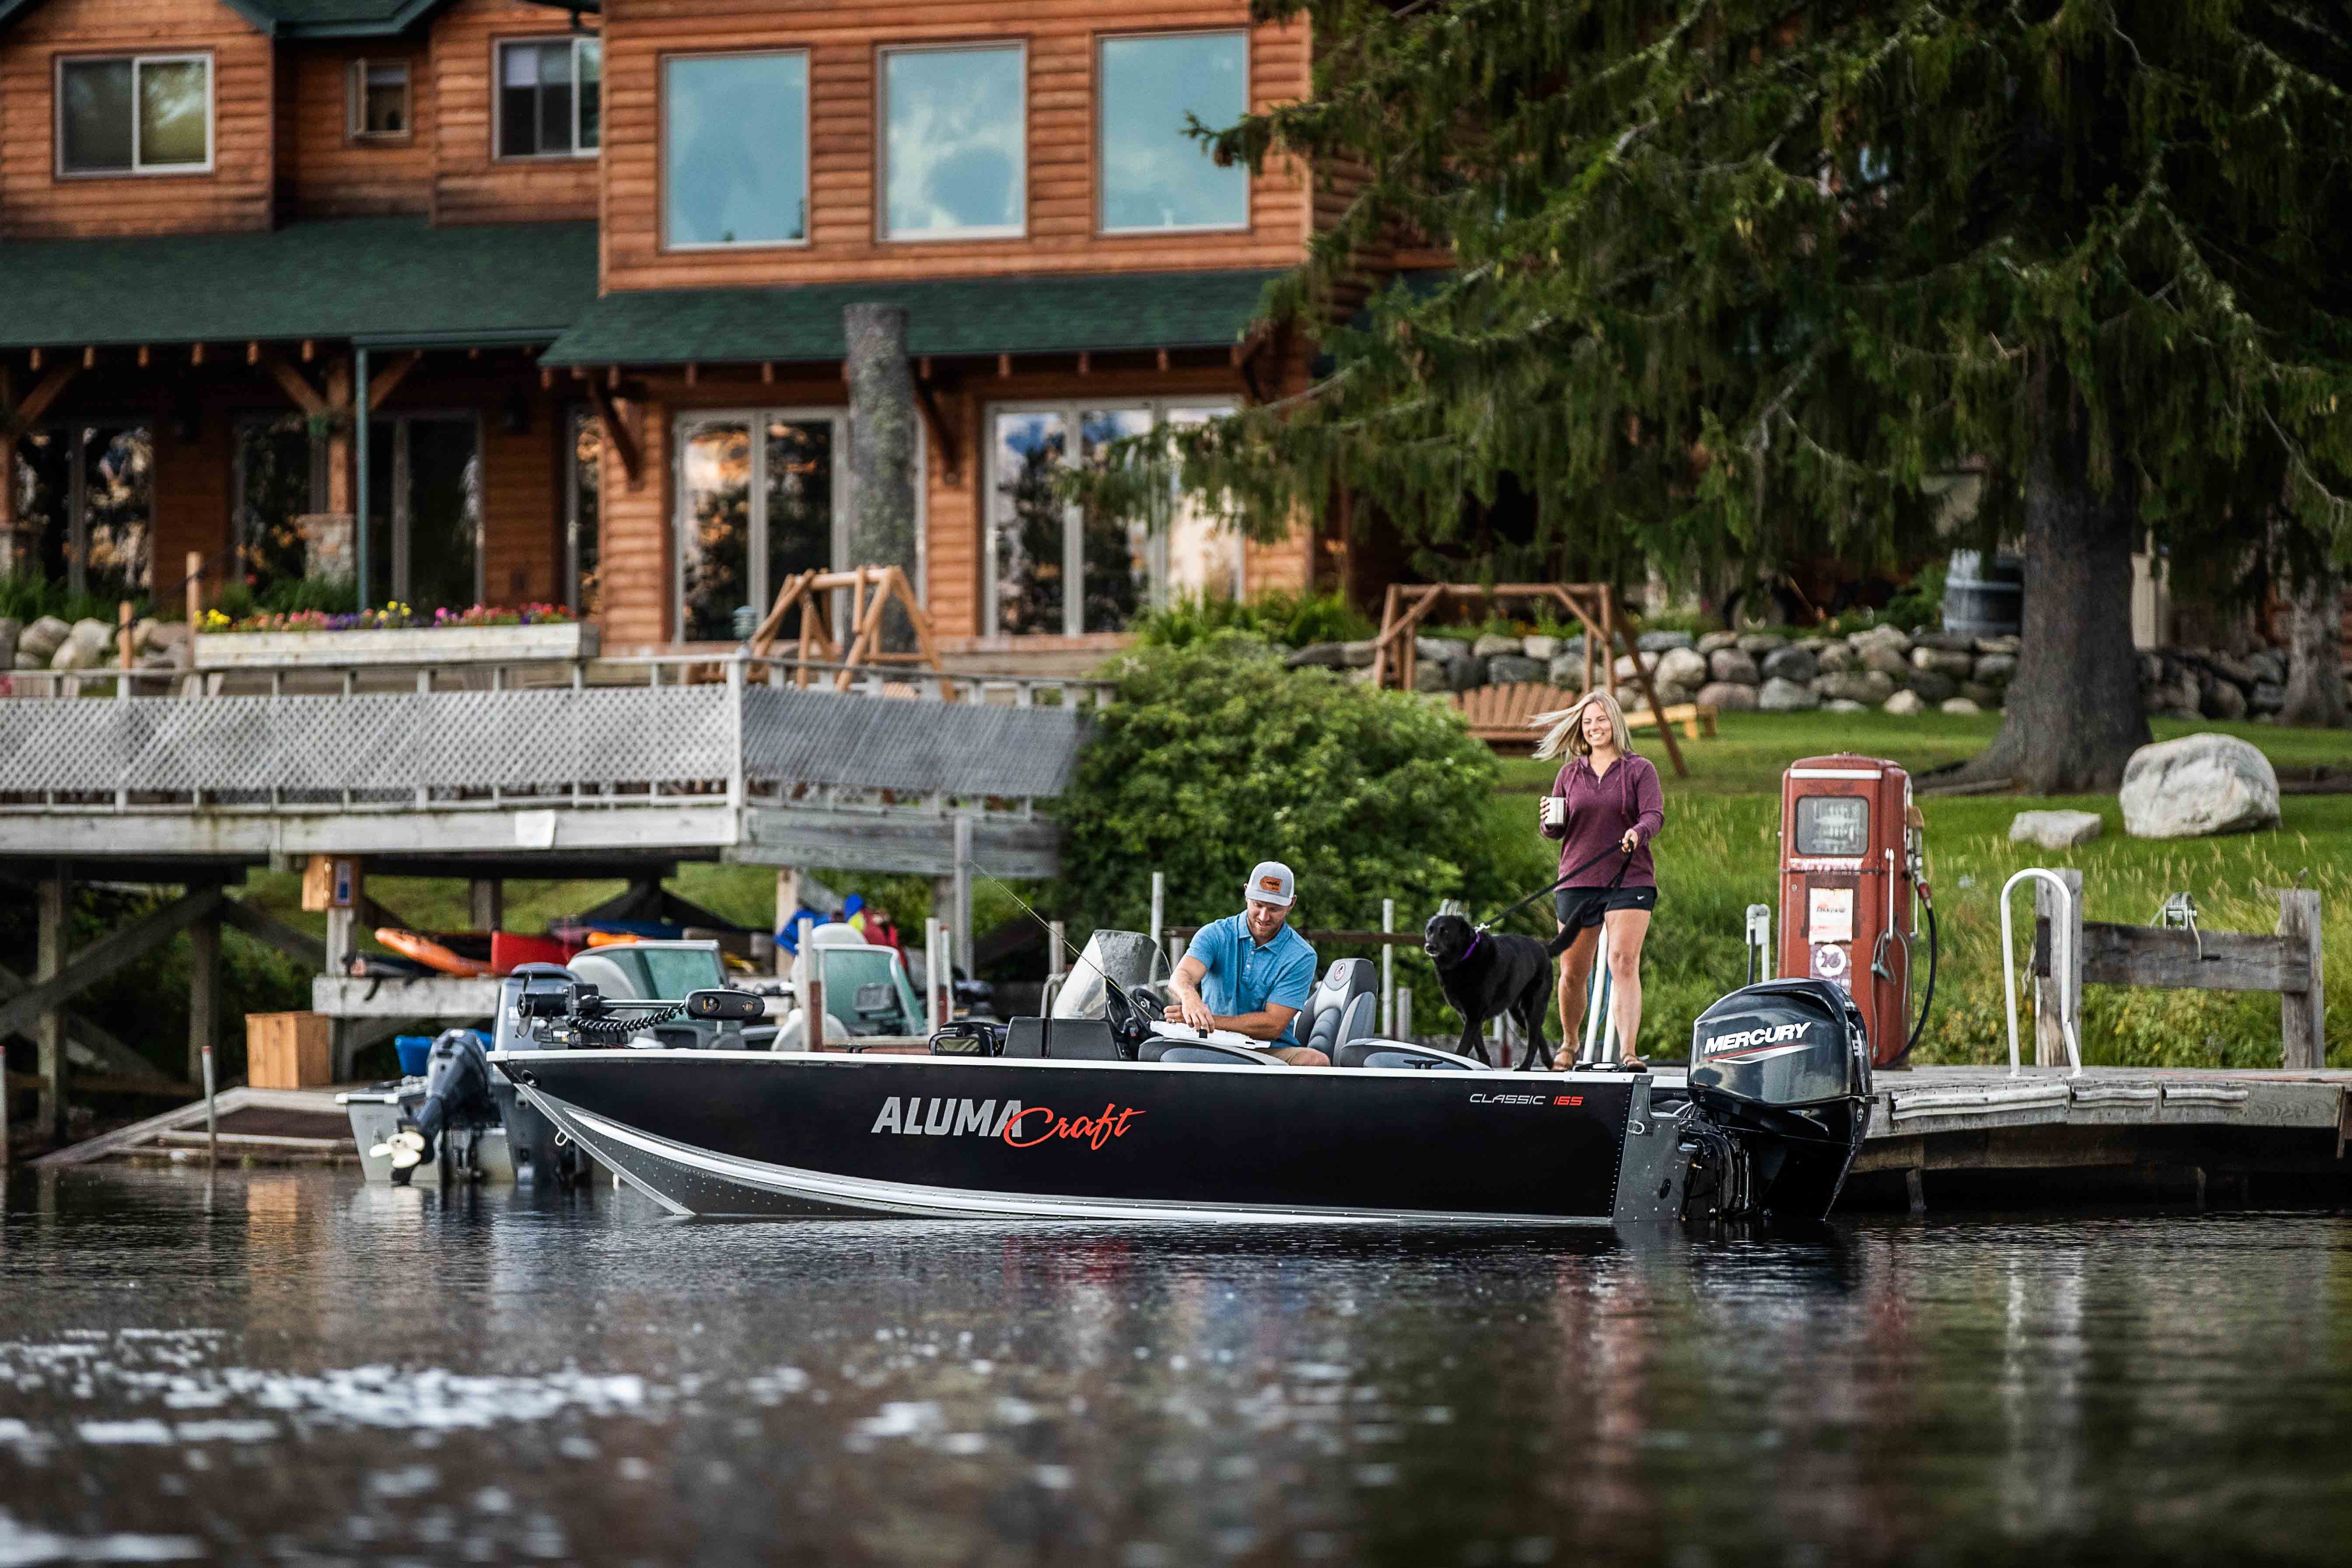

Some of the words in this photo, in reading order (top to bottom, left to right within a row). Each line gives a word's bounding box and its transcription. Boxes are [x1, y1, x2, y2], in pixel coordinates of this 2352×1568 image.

[1704, 1021, 1812, 1054] MERCURY
[1470, 1093, 1546, 1105] CLASSIC
[1553, 1096, 1584, 1106] 165
